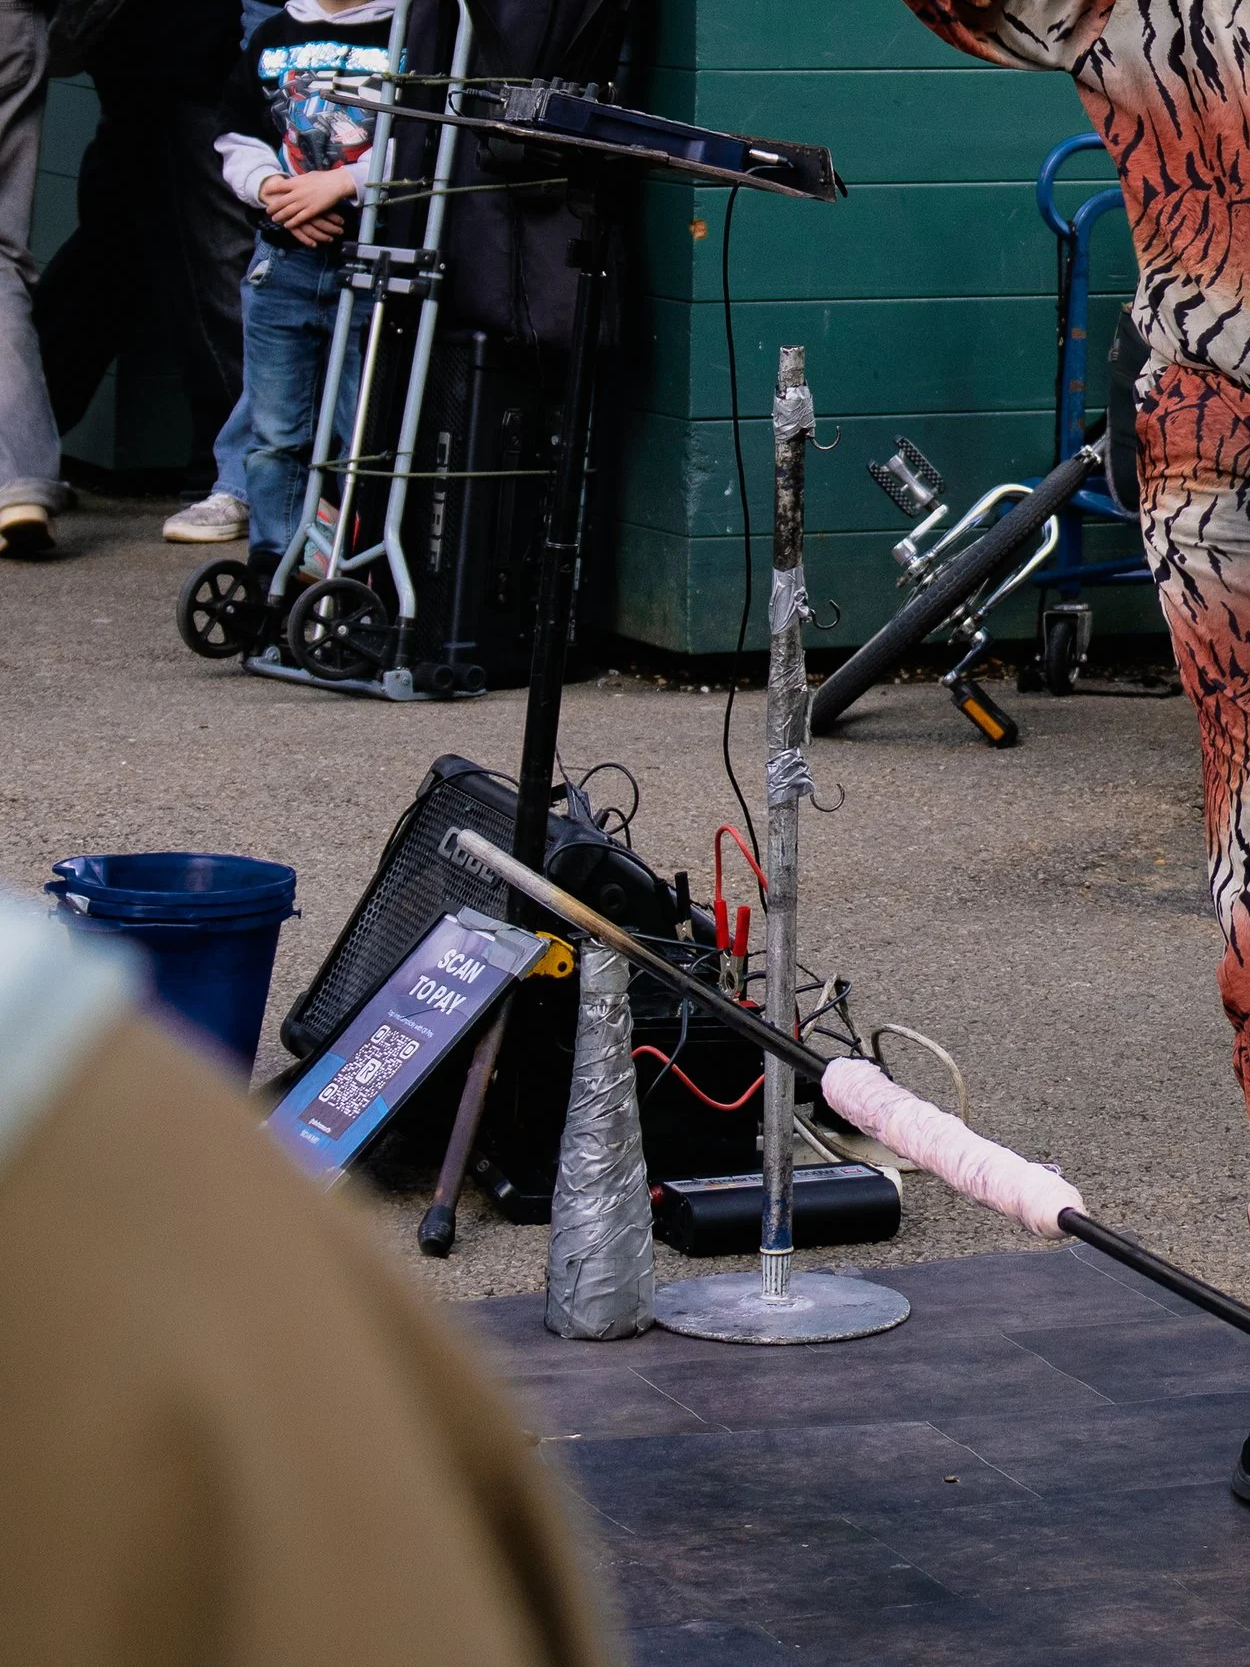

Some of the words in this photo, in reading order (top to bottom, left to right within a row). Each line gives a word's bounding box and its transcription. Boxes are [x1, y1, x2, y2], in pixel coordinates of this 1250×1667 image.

[437, 948, 486, 984] SCAN
[409, 975, 437, 1000] TO
[426, 985, 467, 1015] PAY
